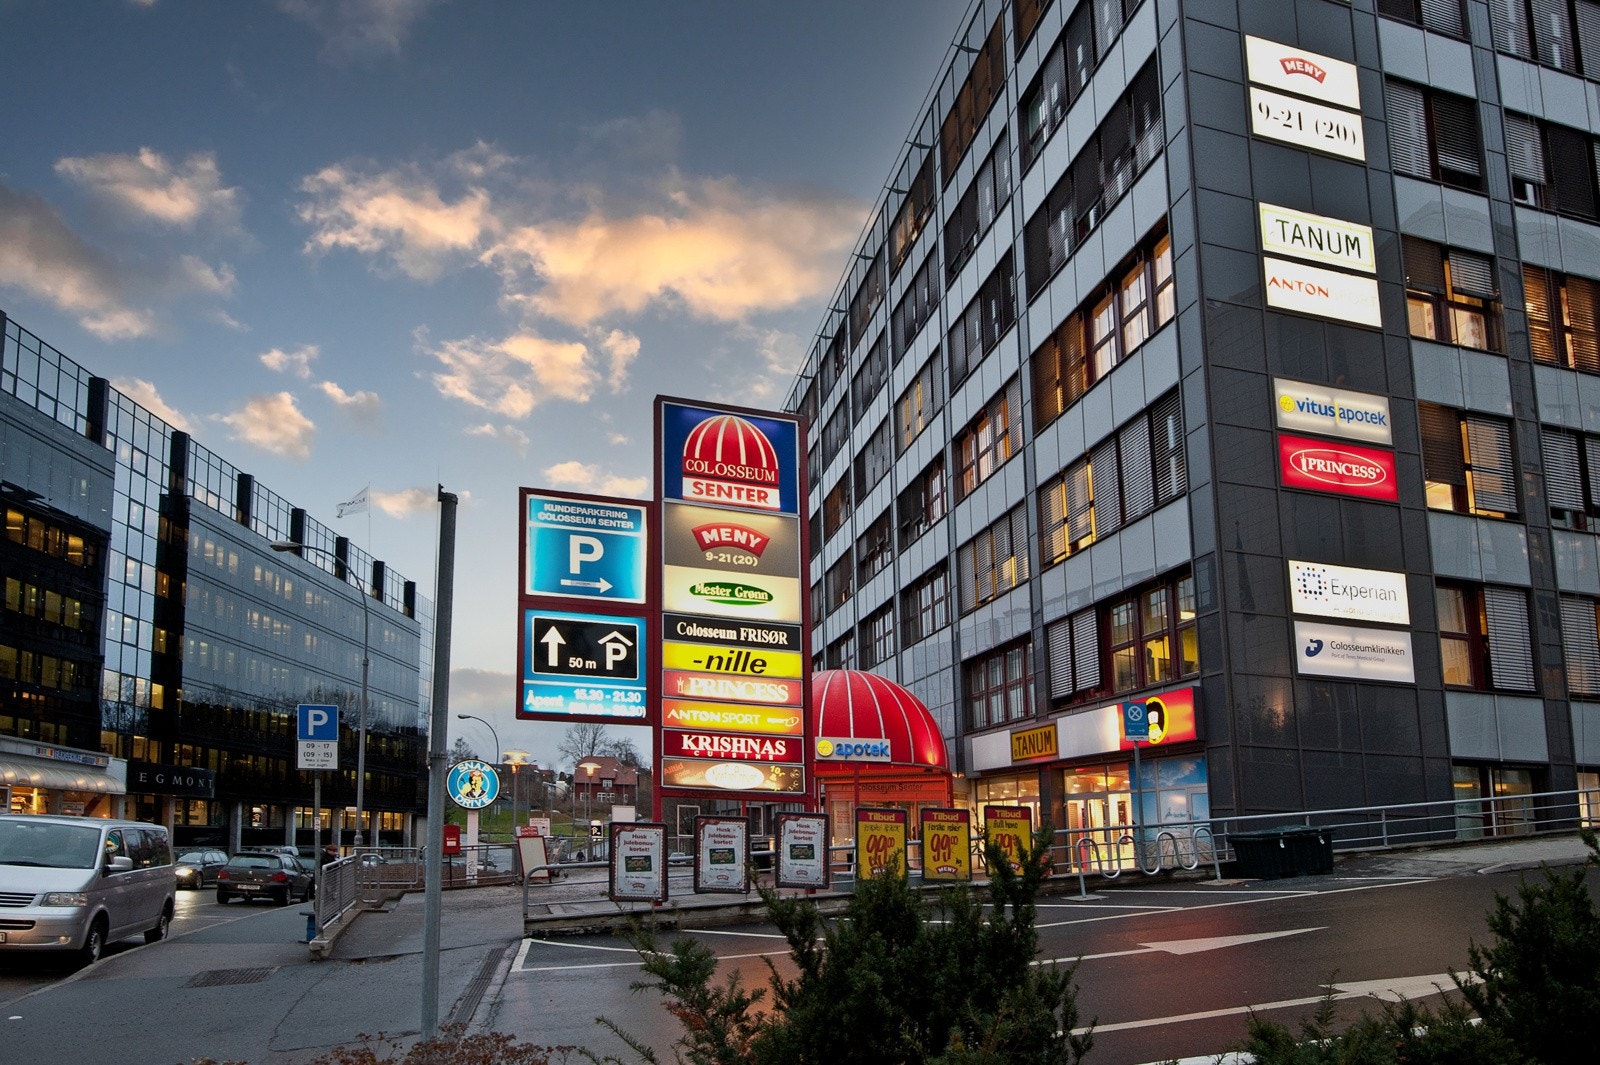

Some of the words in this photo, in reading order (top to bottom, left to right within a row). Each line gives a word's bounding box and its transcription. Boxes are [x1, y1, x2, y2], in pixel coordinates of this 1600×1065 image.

[1284, 60, 1324, 79] MENY
[1258, 101, 1303, 131] 9-21
[1315, 116, 1356, 146] (20)
[1275, 218, 1362, 259] TANUM
[1268, 276, 1329, 298] ANTON
[685, 459, 775, 482] COLOSSEUM
[692, 480, 769, 504] SENTER
[538, 512, 596, 525] COLOSSEUM
[598, 518, 634, 529] SENTER
[544, 503, 628, 519] KUNDEPARKERING
[702, 527, 761, 548] MENY
[569, 534, 604, 575] P
[694, 583, 731, 597] Mester
[1330, 578, 1397, 602] Experian
[677, 622, 736, 640] Colosseum
[740, 627, 788, 645] FRISØR
[1330, 640, 1405, 655] Colosseumklinikken
[568, 656, 583, 668] 50
[585, 659, 597, 669] m
[688, 677, 789, 702] PRINCESS
[308, 710, 328, 735] P
[682, 734, 786, 755] KRISHNAS
[835, 742, 890, 759] apotek
[1016, 731, 1052, 757] TANUM
[457, 761, 490, 772] SNAP
[139, 772, 213, 789] EGMONT
[455, 794, 490, 808] DRIVE
[868, 812, 896, 821] Tilbud
[932, 812, 959, 821] Tilbud
[995, 810, 1022, 818] Tilbud
